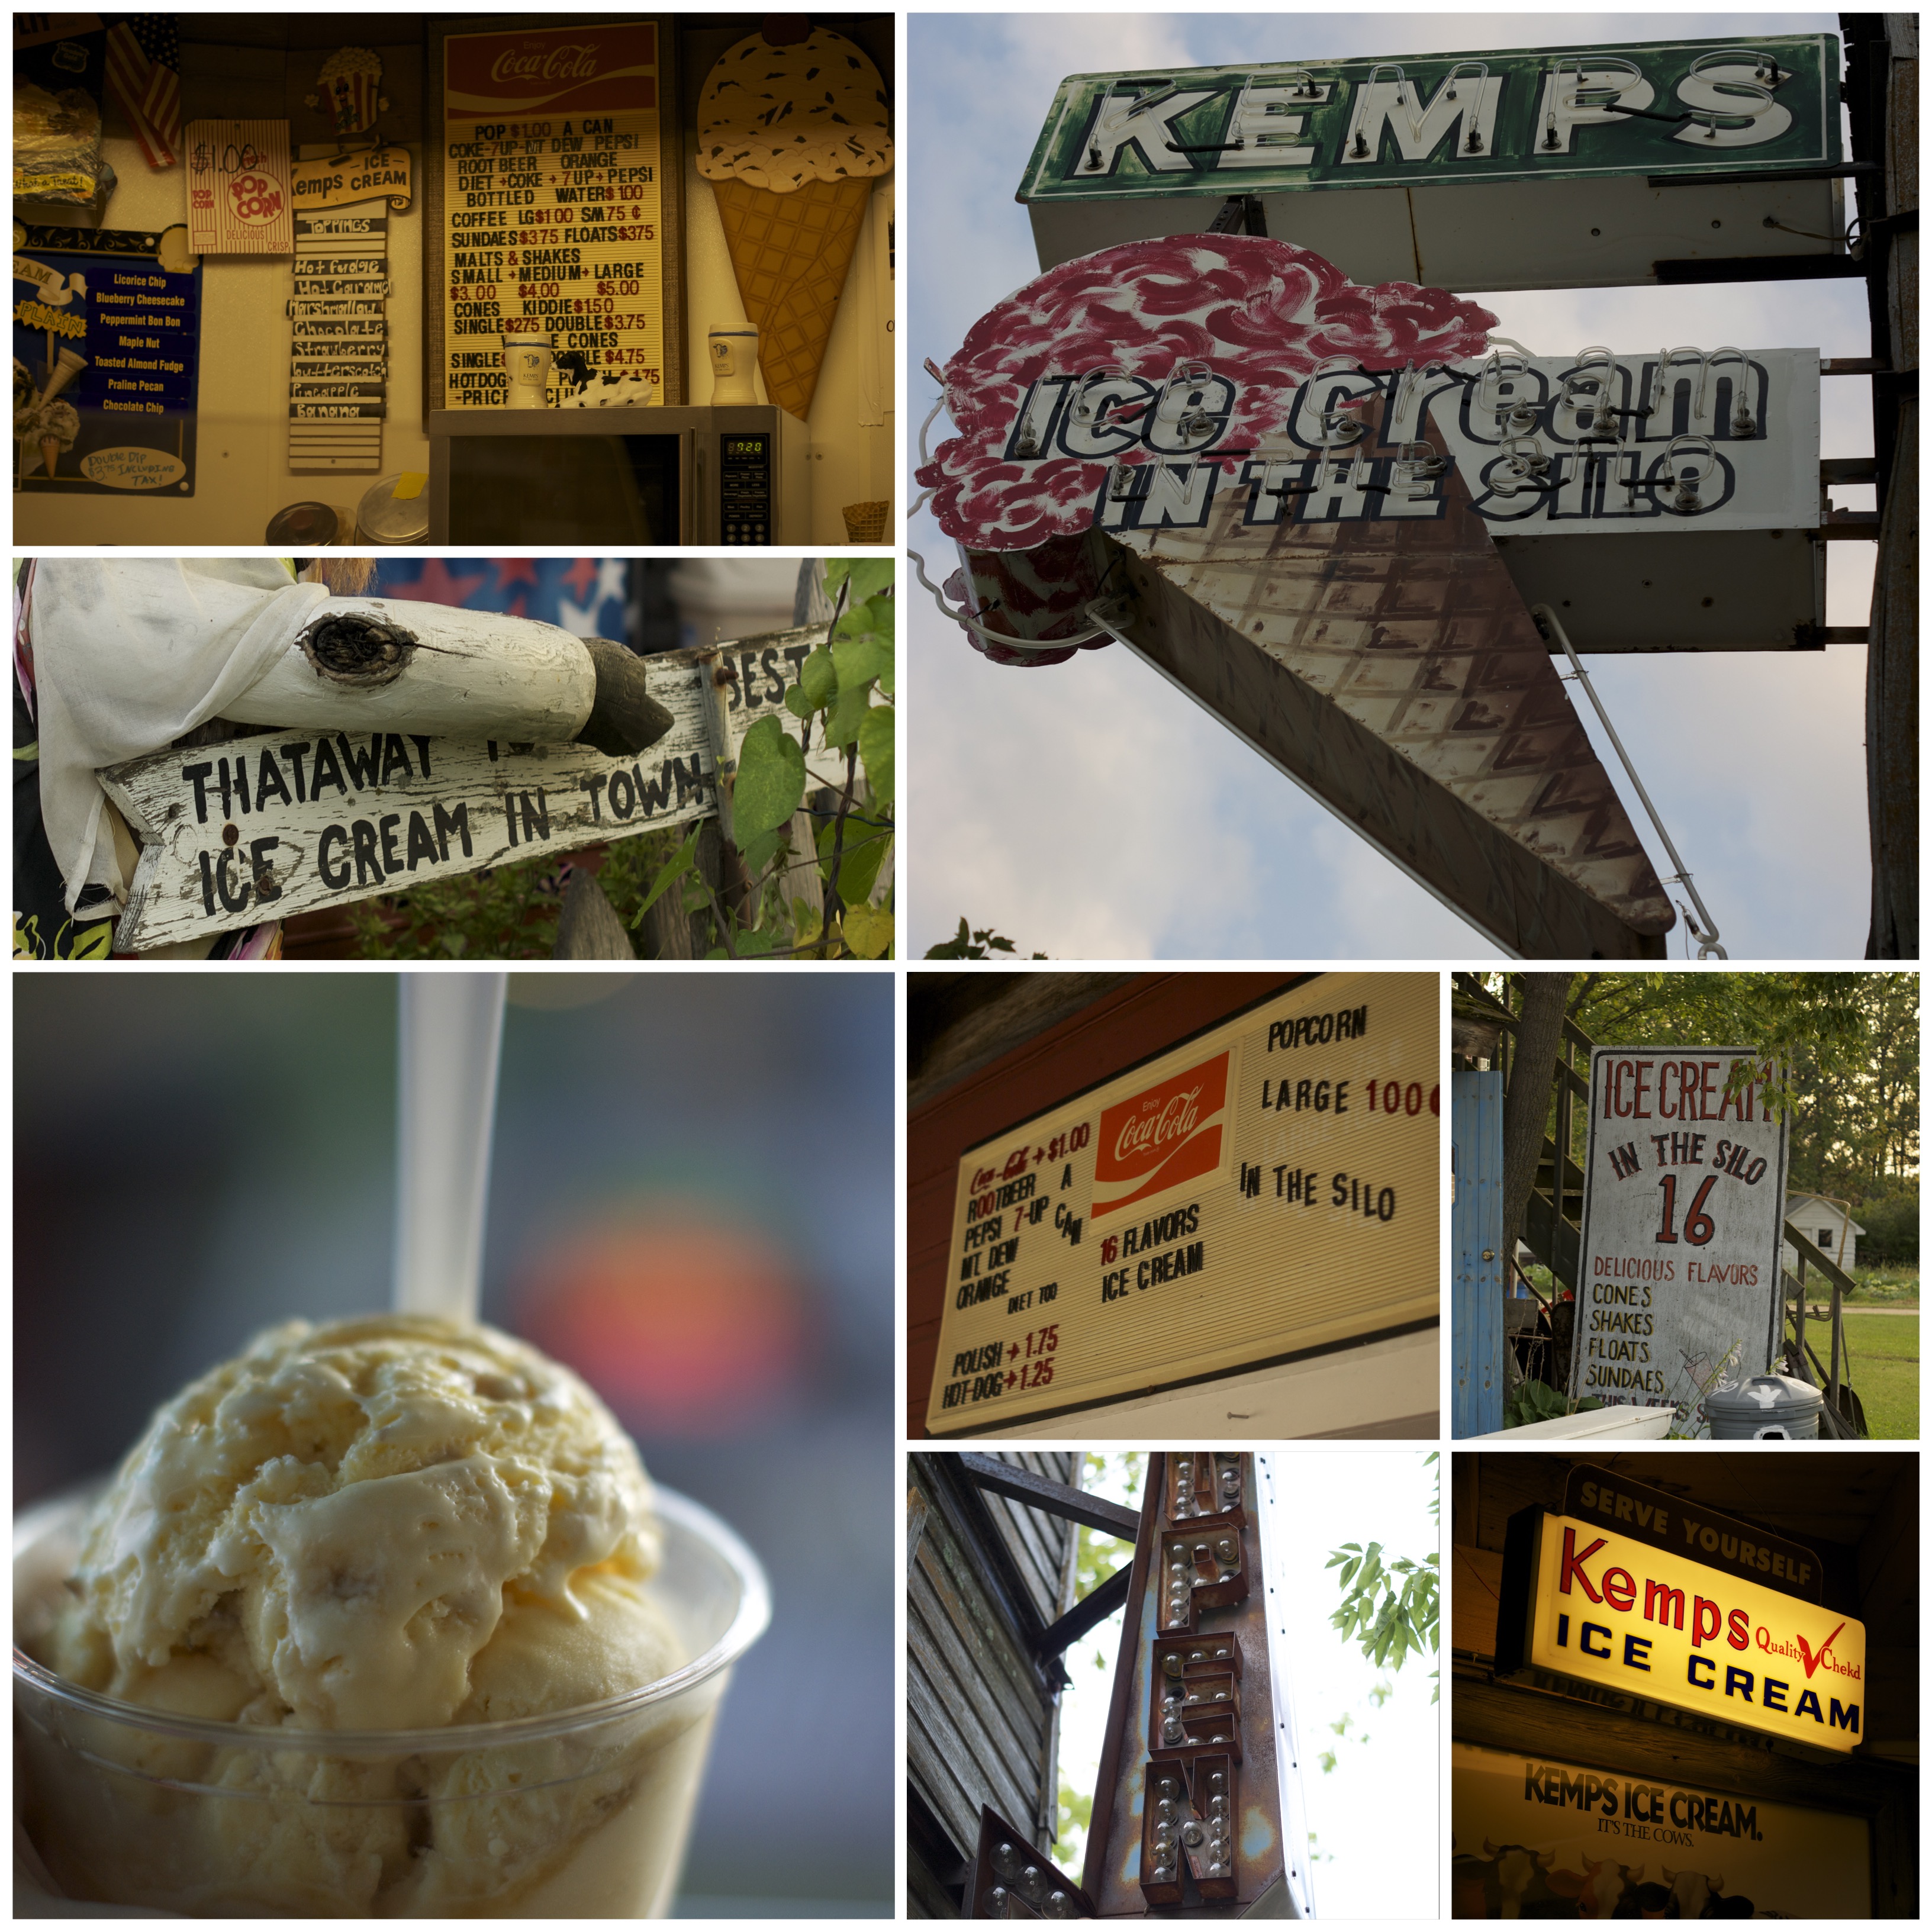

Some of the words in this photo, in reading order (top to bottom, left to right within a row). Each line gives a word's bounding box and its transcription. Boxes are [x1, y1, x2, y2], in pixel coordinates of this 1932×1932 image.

[523, 41, 546, 50] Enjoy
[475, 125, 505, 140] POP
[563, 121, 572, 136] A
[583, 119, 613, 135] CAN
[1068, 64, 1793, 179] KEMPS
[551, 137, 583, 153] DEW
[595, 134, 639, 150] PEPSI
[191, 140, 257, 175] $1.00
[365, 153, 389, 170] ICE
[458, 159, 495, 174] ROOT
[499, 156, 537, 172] BEER
[561, 152, 617, 169] ORANGE
[50, 176, 83, 187] Treat!
[231, 175, 268, 201] POP
[351, 170, 407, 191] CREAM
[459, 175, 494, 191] DIET
[508, 172, 543, 189] COKE
[607, 167, 653, 183] PEPSI
[192, 189, 212, 199] POP
[192, 200, 214, 209] CORN
[237, 191, 282, 218] CORN
[466, 190, 534, 207] BOTTLED
[305, 219, 371, 234] TOPPINGS
[452, 211, 507, 228] COFFEE
[227, 230, 265, 240] DELICIOUS
[268, 242, 289, 252] CRISP
[455, 252, 503, 268] MALTS
[508, 250, 519, 266] &
[522, 248, 580, 266] SHAKES
[295, 260, 325, 274] Hot
[451, 268, 503, 284] SMALL
[519, 265, 581, 282] MEDIUM
[595, 263, 644, 279] LARGE
[114, 273, 146, 286] Licorice
[148, 276, 167, 289] Chip
[298, 281, 329, 294] Hot
[333, 280, 391, 295] Caramel
[450, 285, 496, 301] $3.00
[519, 282, 559, 299] $4.00
[597, 280, 639, 296] $5.00
[96, 292, 135, 305] Blueberry
[137, 294, 185, 307] Cheesecake
[454, 301, 500, 317] CONES
[20, 302, 82, 334] PLAIN
[100, 313, 146, 327] Peppermint
[148, 315, 164, 326] Bon
[165, 316, 181, 327] Bon
[295, 321, 384, 336] Chocolate
[119, 336, 144, 349] Maple
[146, 337, 160, 349] Nut
[295, 342, 385, 356] Strawberry
[568, 332, 619, 349] CONES
[95, 356, 126, 368] Toasted
[128, 358, 158, 370] Almond
[159, 360, 183, 373] Fudge
[605, 349, 645, 365] $4.75
[108, 379, 137, 390] Praline
[139, 380, 164, 392] Pecan
[292, 383, 359, 397] Pineapple
[103, 400, 144, 412] Chocolate
[146, 402, 164, 414] Chip
[297, 404, 360, 418] Banana
[1092, 456, 1215, 531] IN
[1244, 455, 1454, 527] THE
[1467, 444, 1735, 522] SILO
[723, 644, 810, 711] BEST
[182, 733, 431, 824] THATAWAY
[199, 836, 282, 916] ICE
[318, 802, 472, 890] CREAM
[505, 787, 550, 847] IN
[580, 752, 704, 822] TOWN
[1268, 1005, 1367, 1052] POPCORN
[1262, 1079, 1350, 1114] LARGE
[1603, 1060, 1654, 1119] ICE
[1659, 1061, 1773, 1122] CREAM
[1142, 1097, 1161, 1112] Enjoy
[1048, 1122, 1090, 1162] $1.00
[1608, 1142, 1642, 1181] IN
[1651, 1132, 1706, 1167] THE
[1712, 1139, 1767, 1185] SILO
[1061, 1163, 1072, 1190] A
[1240, 1163, 1261, 1199] IN
[1273, 1164, 1317, 1206] THE
[1332, 1173, 1395, 1221] SILO
[1656, 1174, 1718, 1246] 16
[964, 1215, 1002, 1252] PEPSI
[1055, 1203, 1083, 1246] CAN
[1100, 1235, 1118, 1266] 16
[1123, 1203, 1199, 1258] FLAVORS
[961, 1252, 982, 1281] MT
[988, 1237, 1019, 1270] DEW
[1102, 1267, 1129, 1303] ICE
[1137, 1241, 1203, 1290] CREAM
[1594, 1257, 1675, 1281] DELICIOUS
[1688, 1262, 1758, 1286] FLAVORS
[957, 1270, 1010, 1310] ORANGE
[1007, 1291, 1033, 1314] DIET
[1039, 1282, 1057, 1305] TOO
[1593, 1283, 1651, 1308] CONES
[1590, 1309, 1654, 1336] SHAKES
[953, 1341, 1003, 1377] POLISH
[1025, 1324, 1060, 1358] 1.75
[1588, 1338, 1650, 1363] FLOATS
[1020, 1357, 1055, 1390] 1.25
[1586, 1364, 1665, 1393] SUNDAES
[1580, 1481, 1669, 1534] SERVE
[1682, 1518, 1811, 1585] YOURSELF
[1559, 1527, 1750, 1651] Kemps
[1756, 1627, 1805, 1662] Quality
[1821, 1647, 1862, 1680] Chekd
[1557, 1614, 1652, 1672] ICE
[1688, 1654, 1860, 1734] CREAM
[1525, 1763, 1619, 1816] KEMPS
[1625, 1782, 1664, 1824] ICE
[1598, 1818, 1620, 1834] IT'S
[1622, 1822, 1651, 1840] THE
